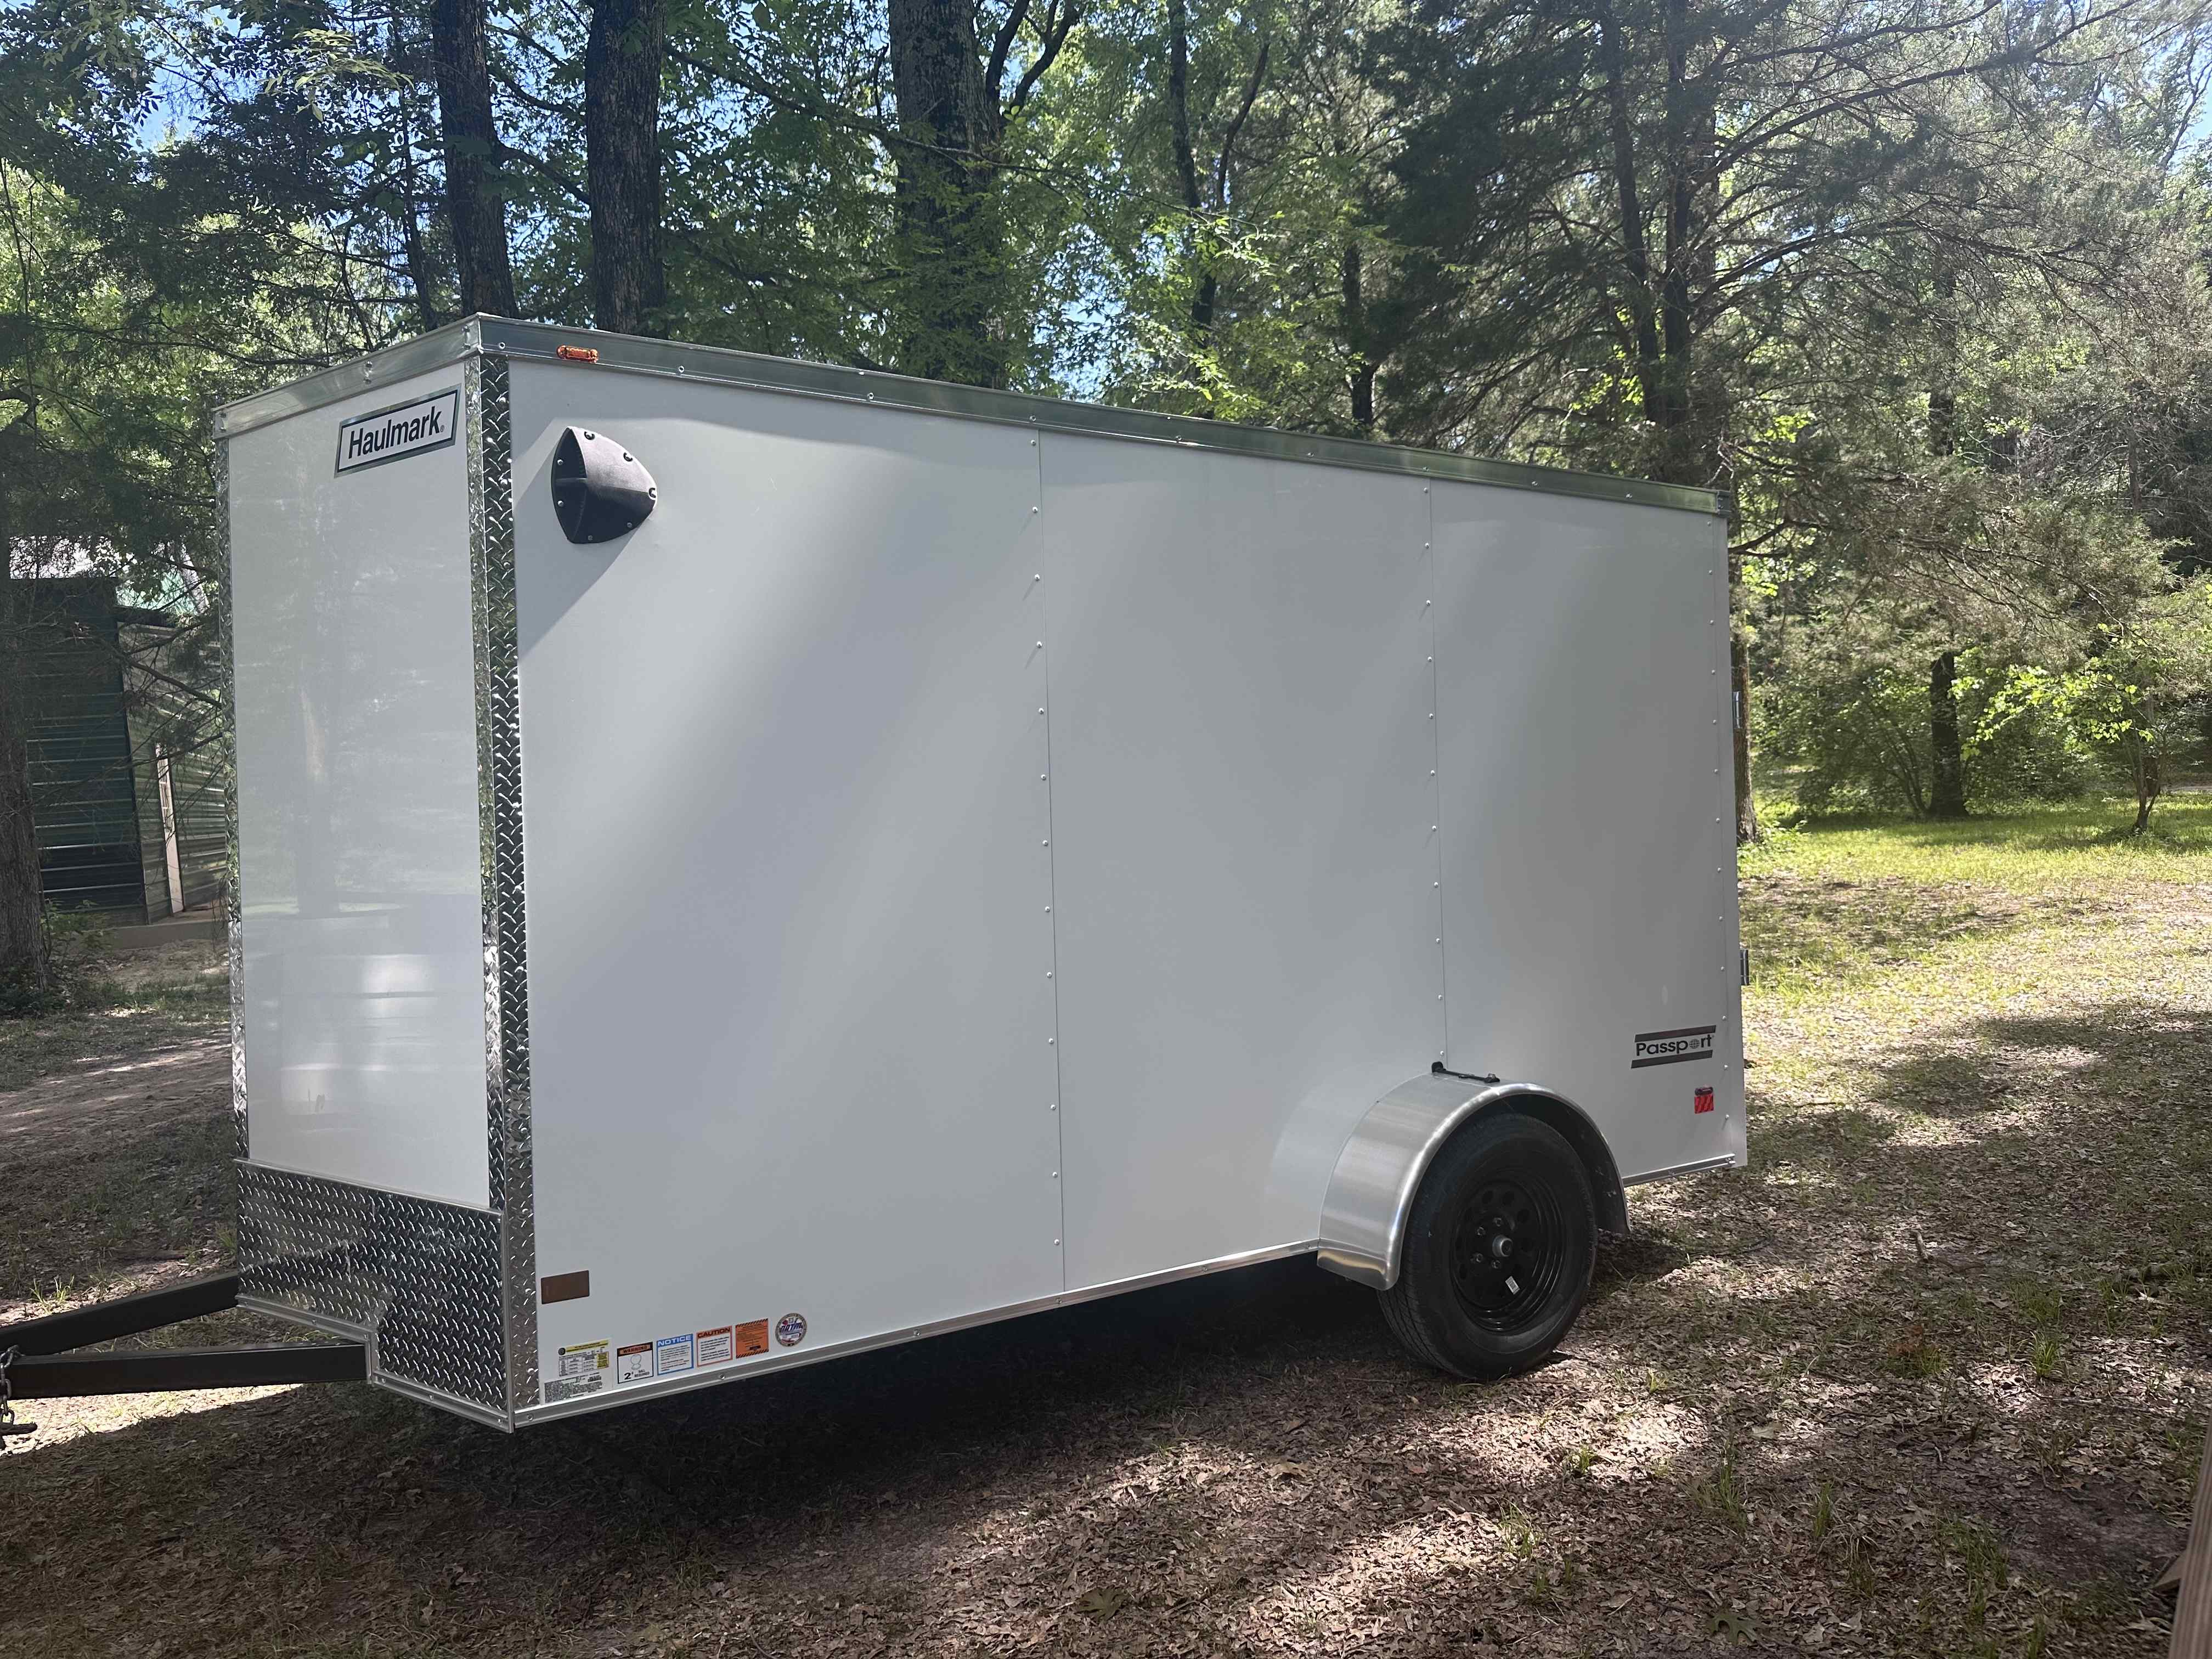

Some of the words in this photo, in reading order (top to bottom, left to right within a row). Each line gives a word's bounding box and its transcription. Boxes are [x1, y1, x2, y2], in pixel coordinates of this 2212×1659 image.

[348, 406, 442, 459] Haulmark
[1636, 1034, 1712, 1056] Passport
[658, 1335, 691, 1346] NOTICE
[697, 1327, 730, 1339] CAUTION
